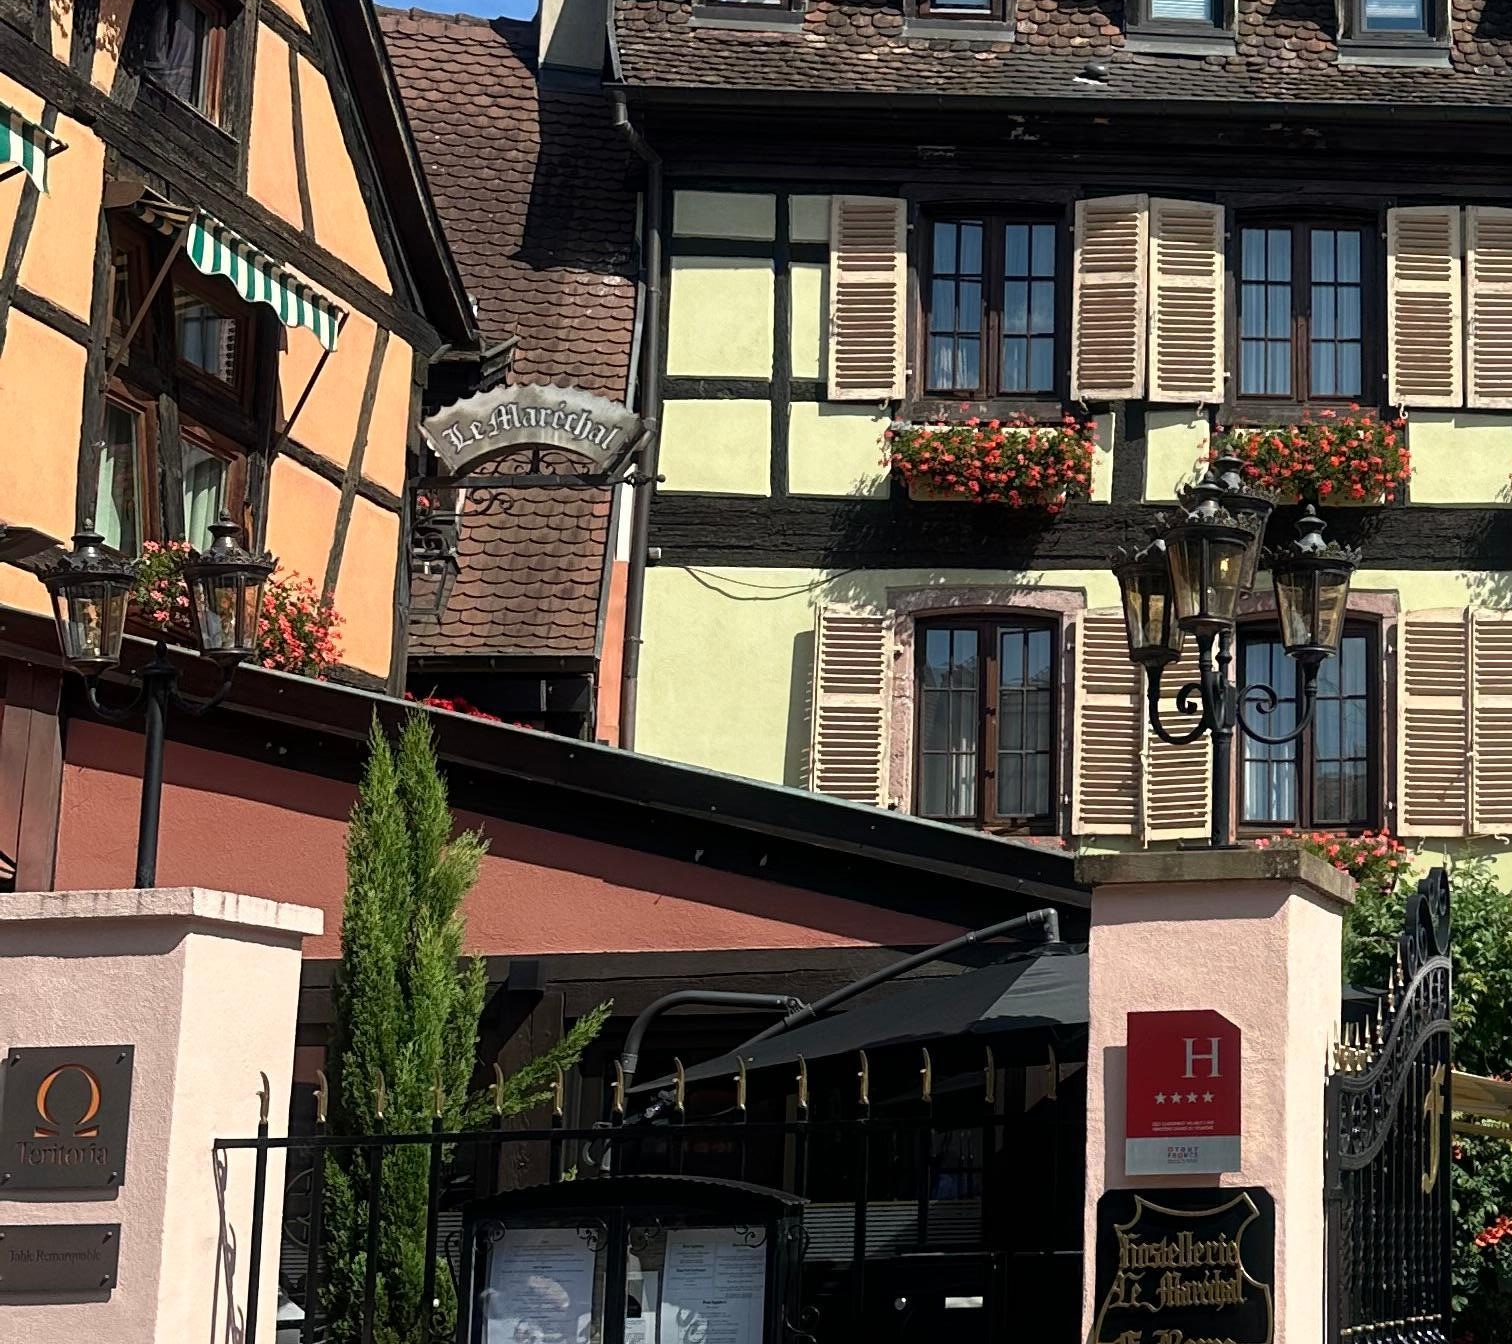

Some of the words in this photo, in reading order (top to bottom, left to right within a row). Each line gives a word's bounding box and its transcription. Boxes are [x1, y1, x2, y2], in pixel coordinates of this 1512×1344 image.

[442, 421, 486, 454] Le
[488, 401, 623, 451] Maréchal
[1183, 1037, 1224, 1079] H
[17, 1140, 109, 1169] Teritoria
